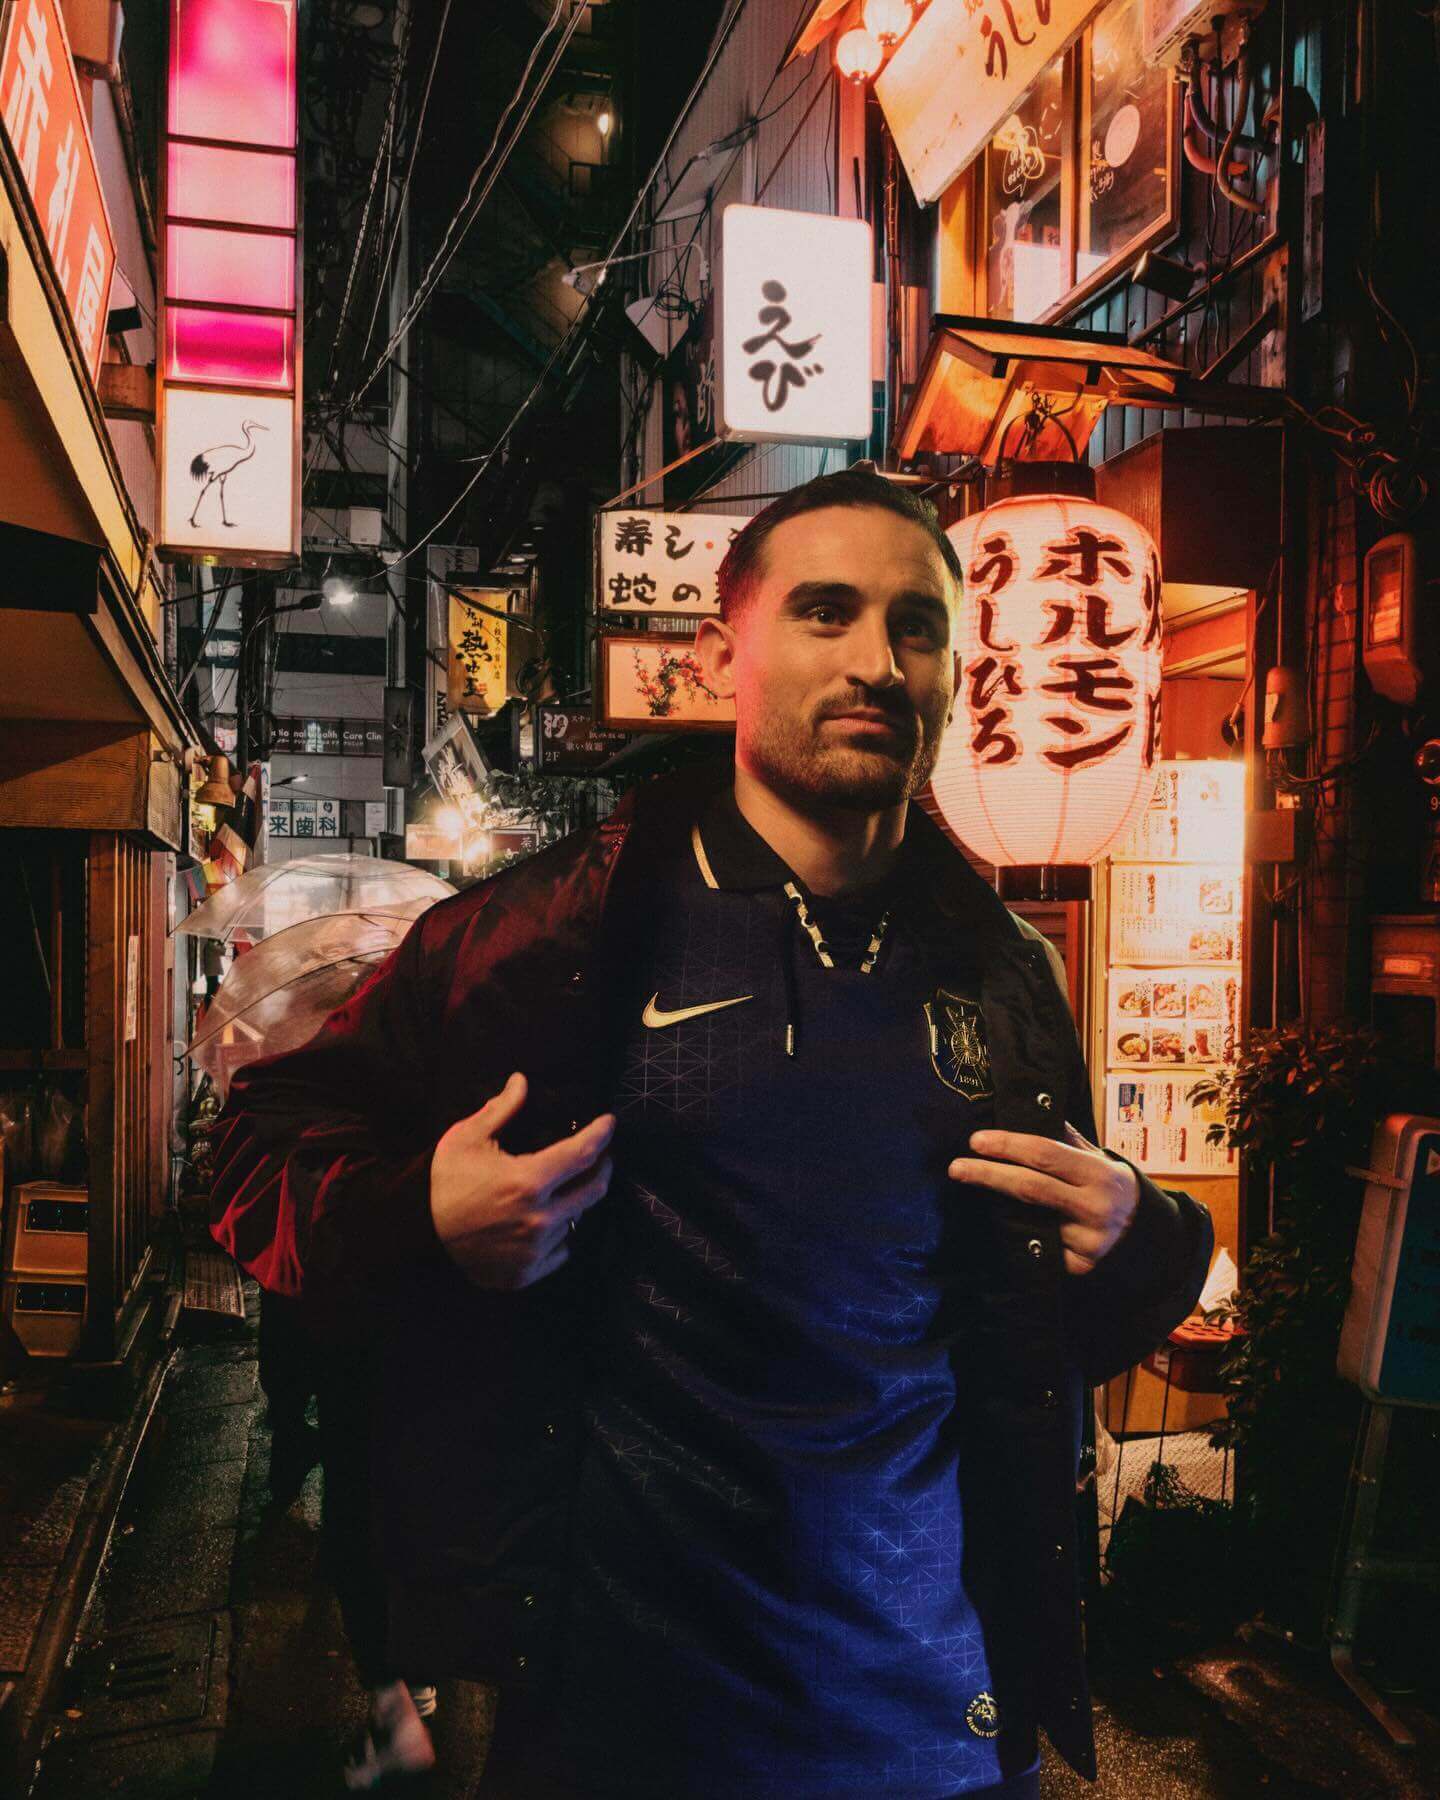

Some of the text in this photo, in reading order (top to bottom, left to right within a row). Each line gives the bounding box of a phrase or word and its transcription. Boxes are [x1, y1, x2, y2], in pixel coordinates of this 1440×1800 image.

[981, 0, 1050, 81] うし
[744, 280, 826, 412] えび
[608, 573, 722, 606] 蛇の
[969, 537, 1022, 764] うしひろ
[1036, 531, 1140, 768] ホルモン
[343, 731, 363, 740] Care
[544, 752, 560, 762] 2F
